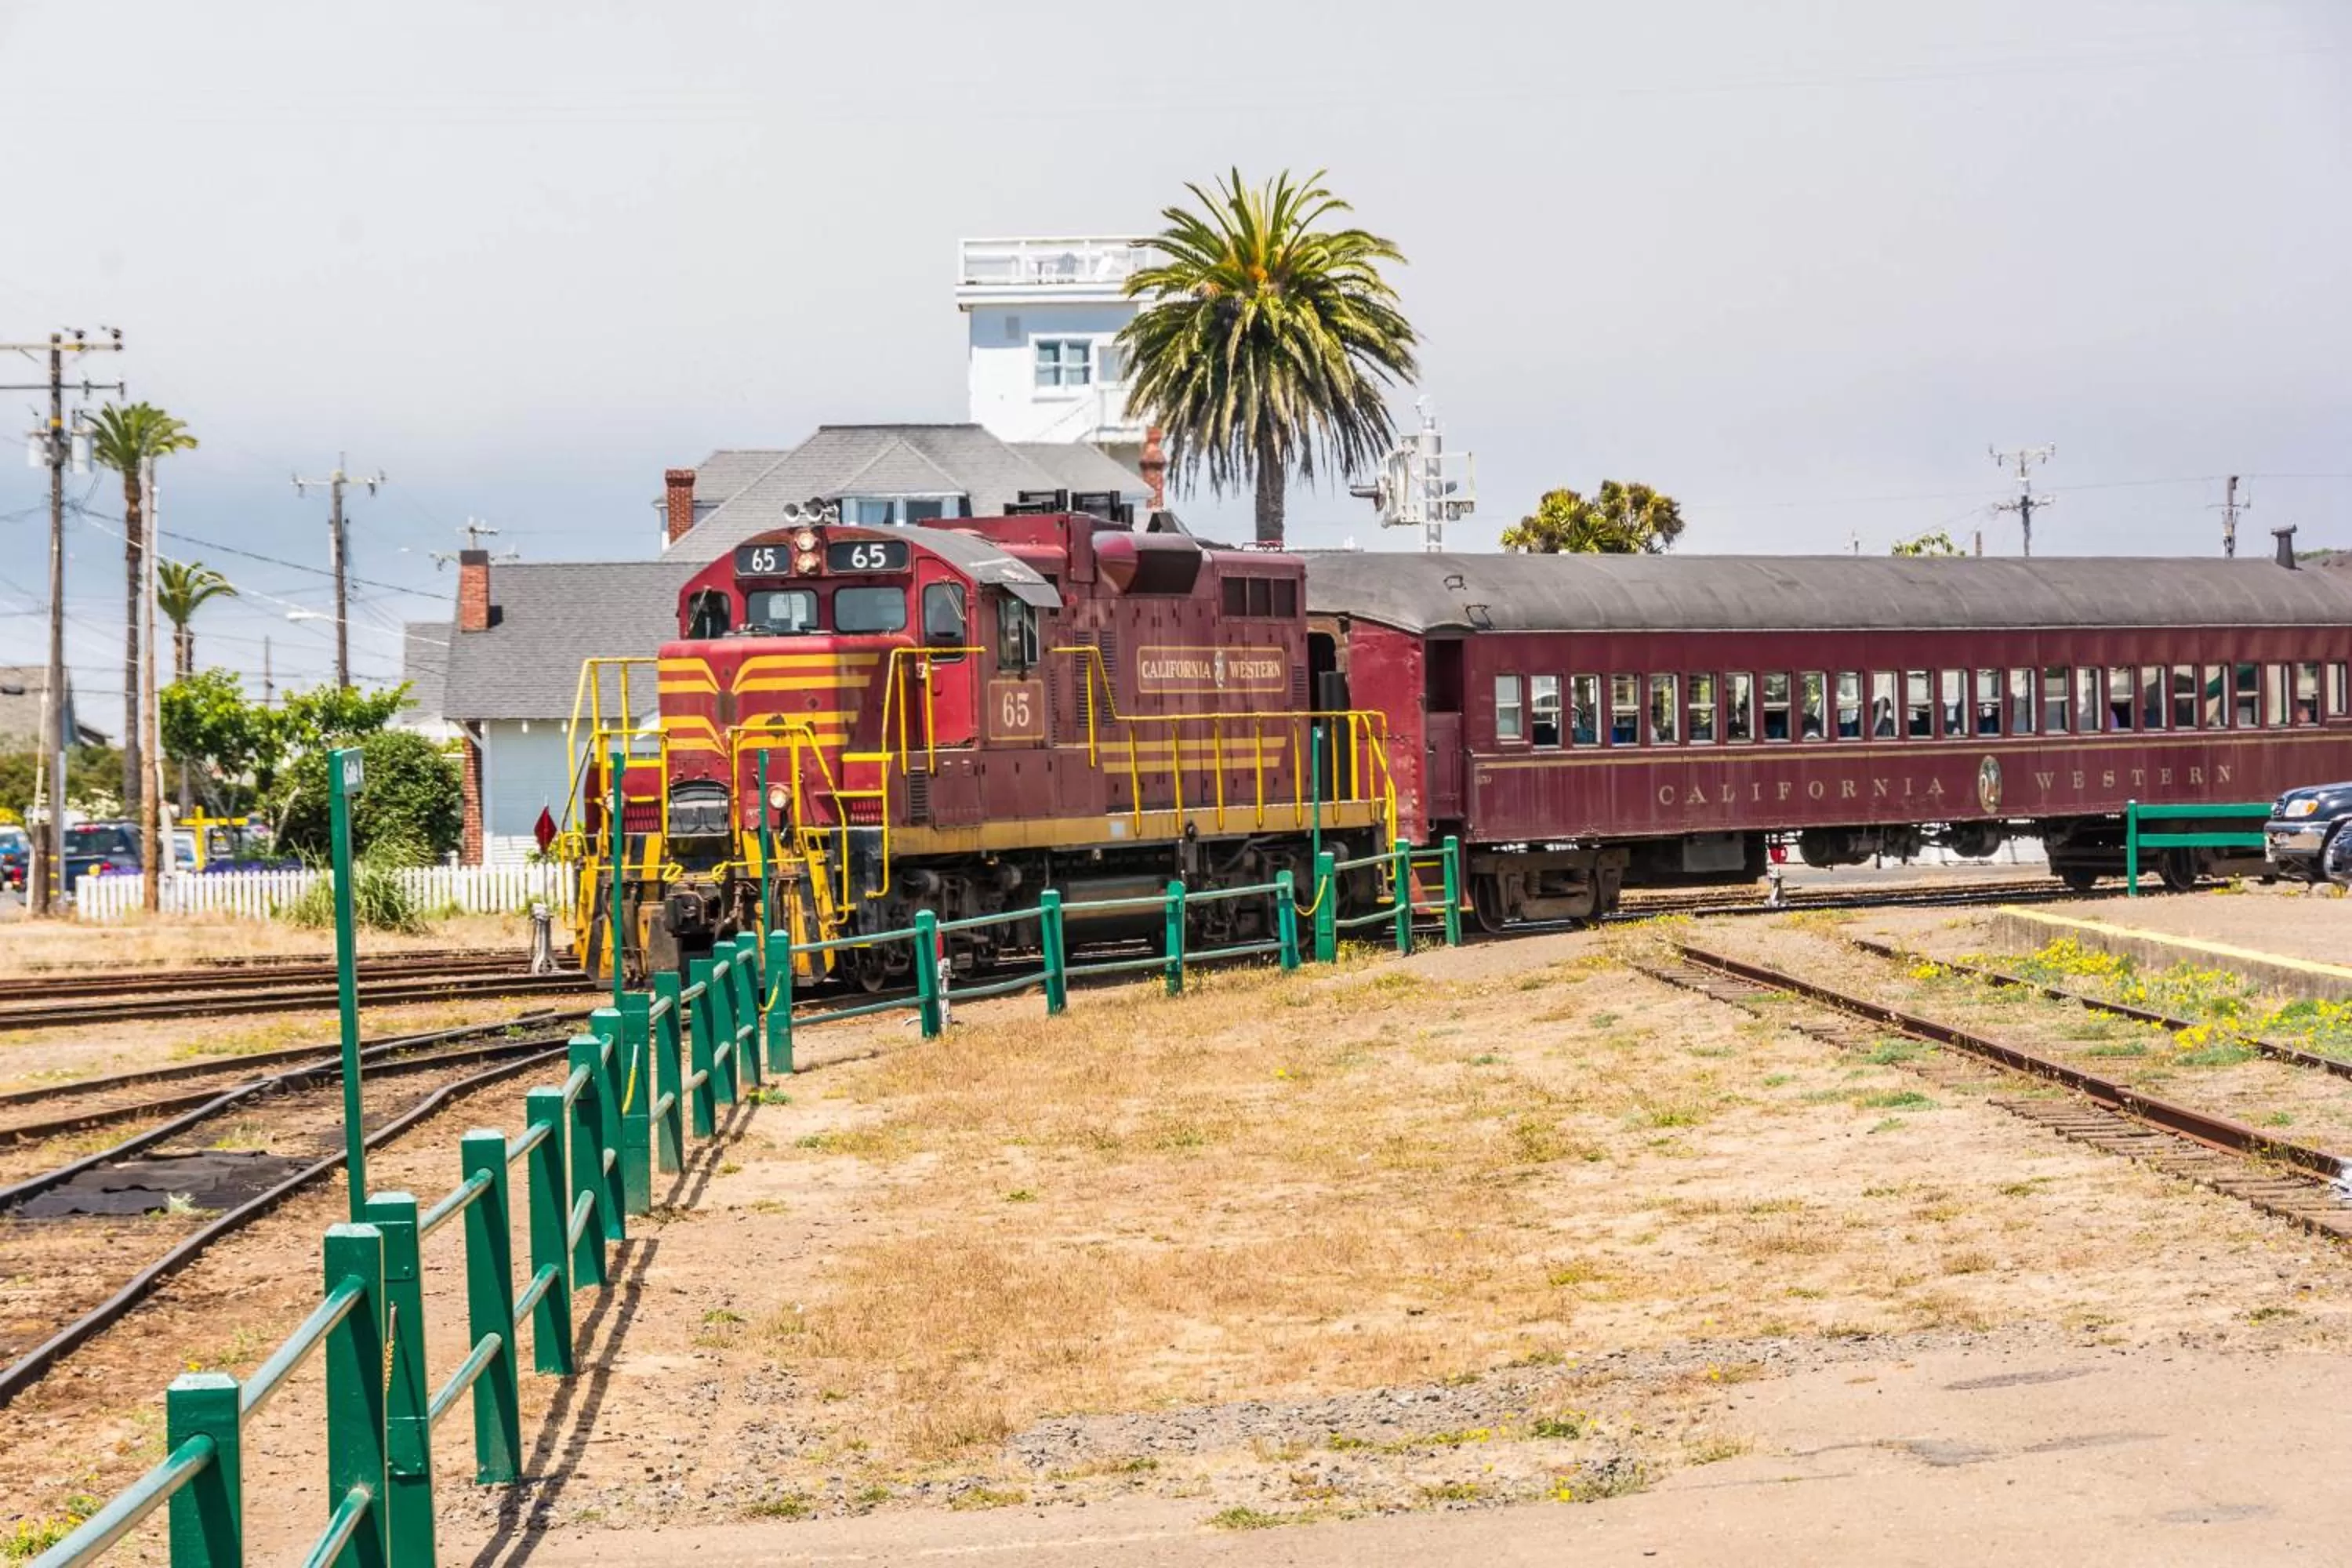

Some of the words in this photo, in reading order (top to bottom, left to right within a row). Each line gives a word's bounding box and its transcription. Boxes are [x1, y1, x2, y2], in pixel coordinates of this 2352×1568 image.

[752, 548, 775, 572] 65
[851, 544, 886, 568] 65
[1142, 660, 1211, 679] CALIFORNIA
[1229, 660, 1281, 678] WESTERN
[1003, 691, 1029, 728] 65
[1658, 776, 1945, 806] CALIFORNIA
[2035, 764, 2232, 790] WESTERN
